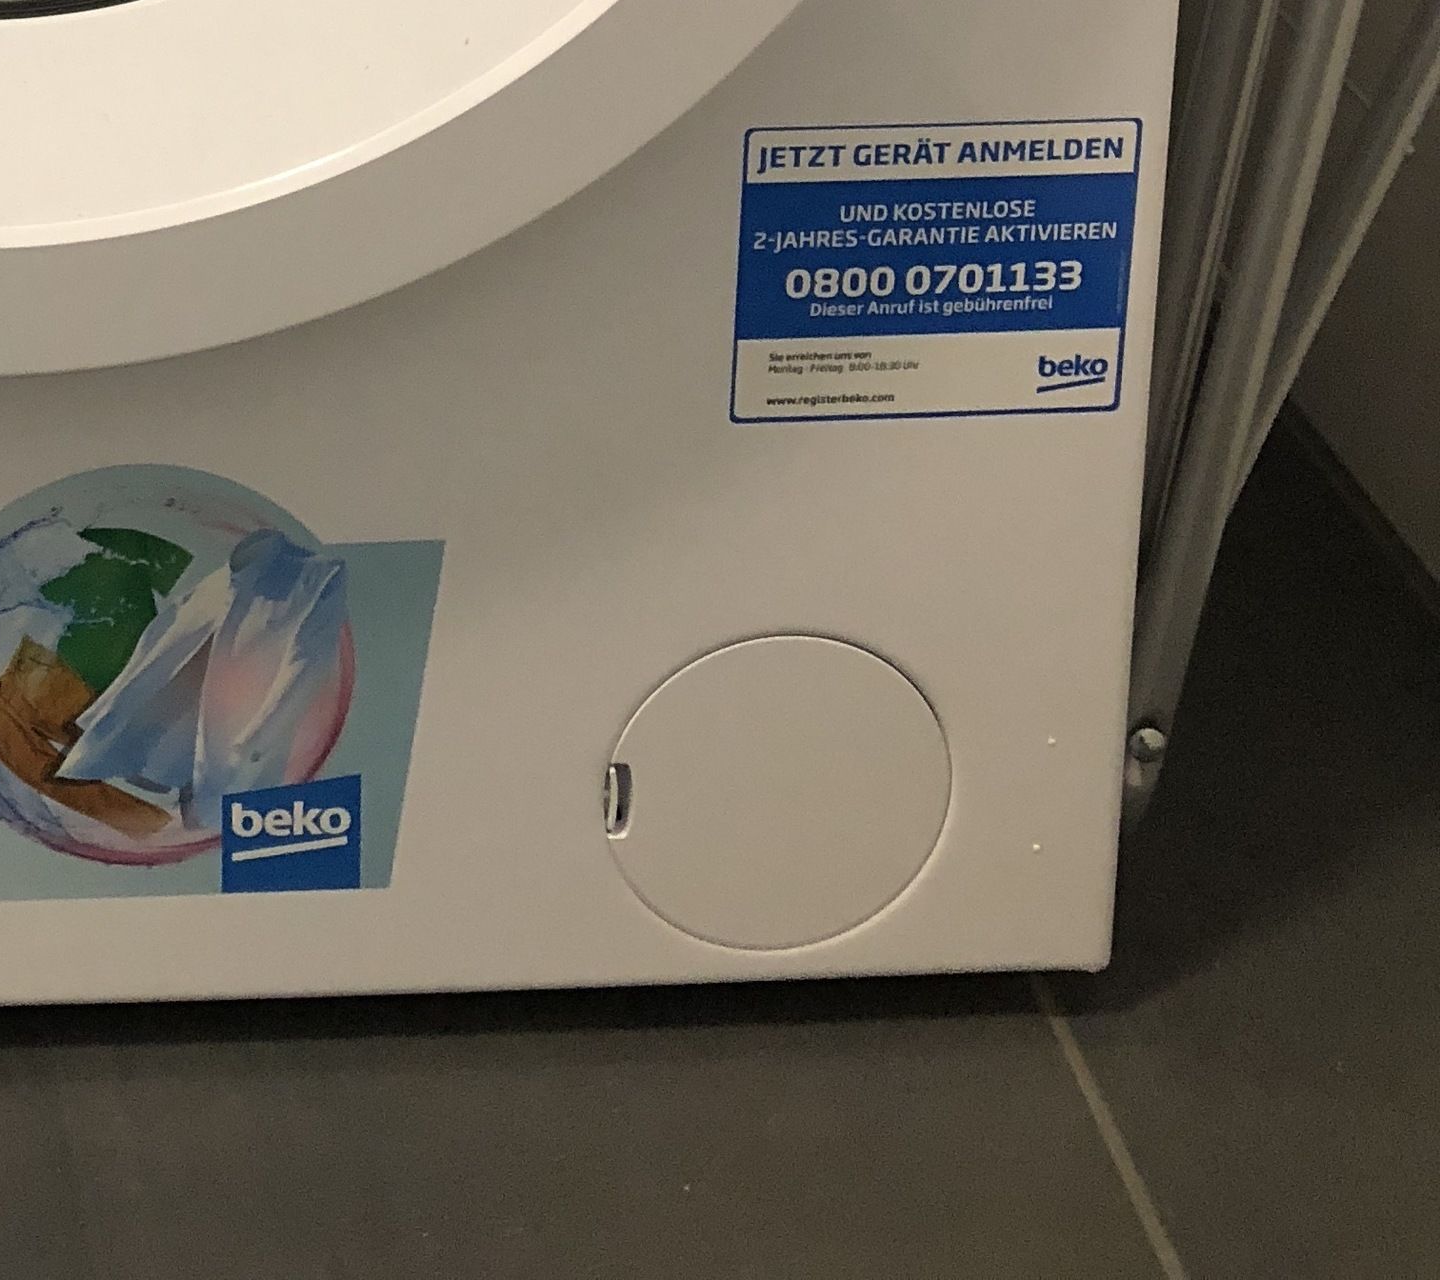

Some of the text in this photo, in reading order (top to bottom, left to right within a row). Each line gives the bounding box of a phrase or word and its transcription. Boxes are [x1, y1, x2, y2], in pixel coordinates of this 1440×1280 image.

[757, 136, 1124, 174] JETZT GERÄT ANMELDEN
[840, 200, 1036, 223] UND KOSTENLOSE
[753, 222, 1117, 253] 2-JAHRES-GARANTIE AKTIVIEREN
[785, 260, 1083, 299] 0800 0701133
[810, 296, 1053, 317] Dieser Anruf ist gebührenfrei
[1038, 353, 1108, 377] beko
[766, 393, 895, 407] www.registerbeko.com
[231, 800, 352, 838] beko
